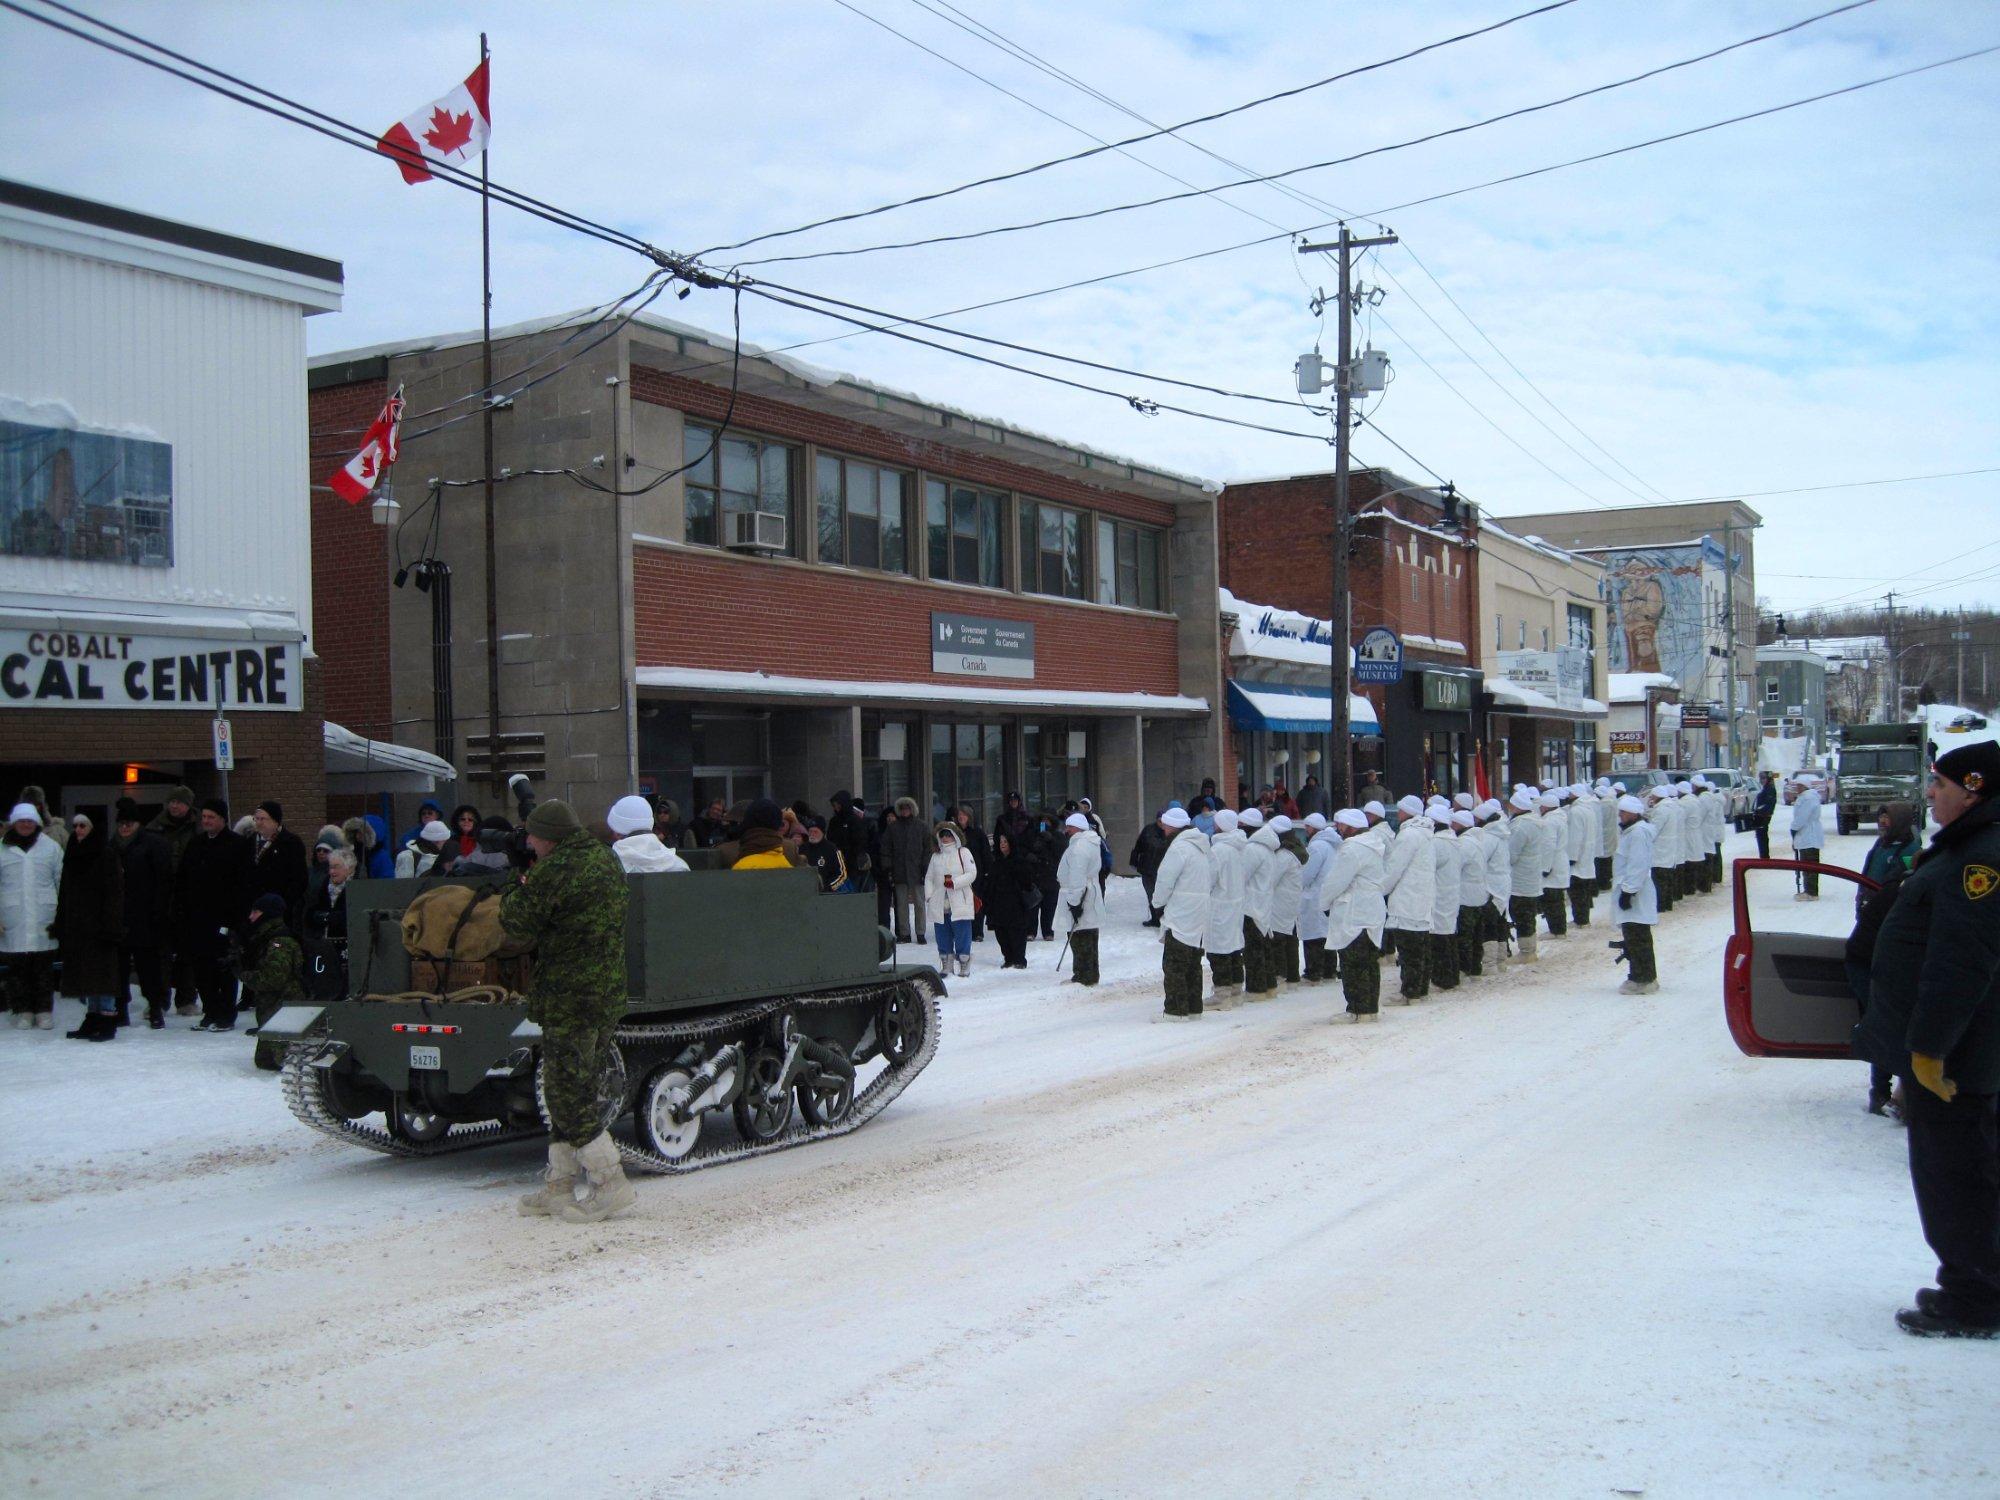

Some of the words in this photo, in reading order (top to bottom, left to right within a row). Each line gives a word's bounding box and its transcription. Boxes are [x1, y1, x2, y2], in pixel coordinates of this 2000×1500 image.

[960, 624, 988, 635] Government
[994, 628, 1025, 639] Gouvernement
[961, 635, 967, 643] of
[967, 635, 985, 645] Canada
[1002, 639, 1019, 648] Canada
[28, 633, 132, 659] COBALT
[961, 656, 987, 671] Canada
[1, 653, 104, 699] CAL
[124, 646, 286, 703] CENTRE
[1357, 671, 1397, 680] MUSEUM
[1610, 732, 1641, 741] 9-5493
